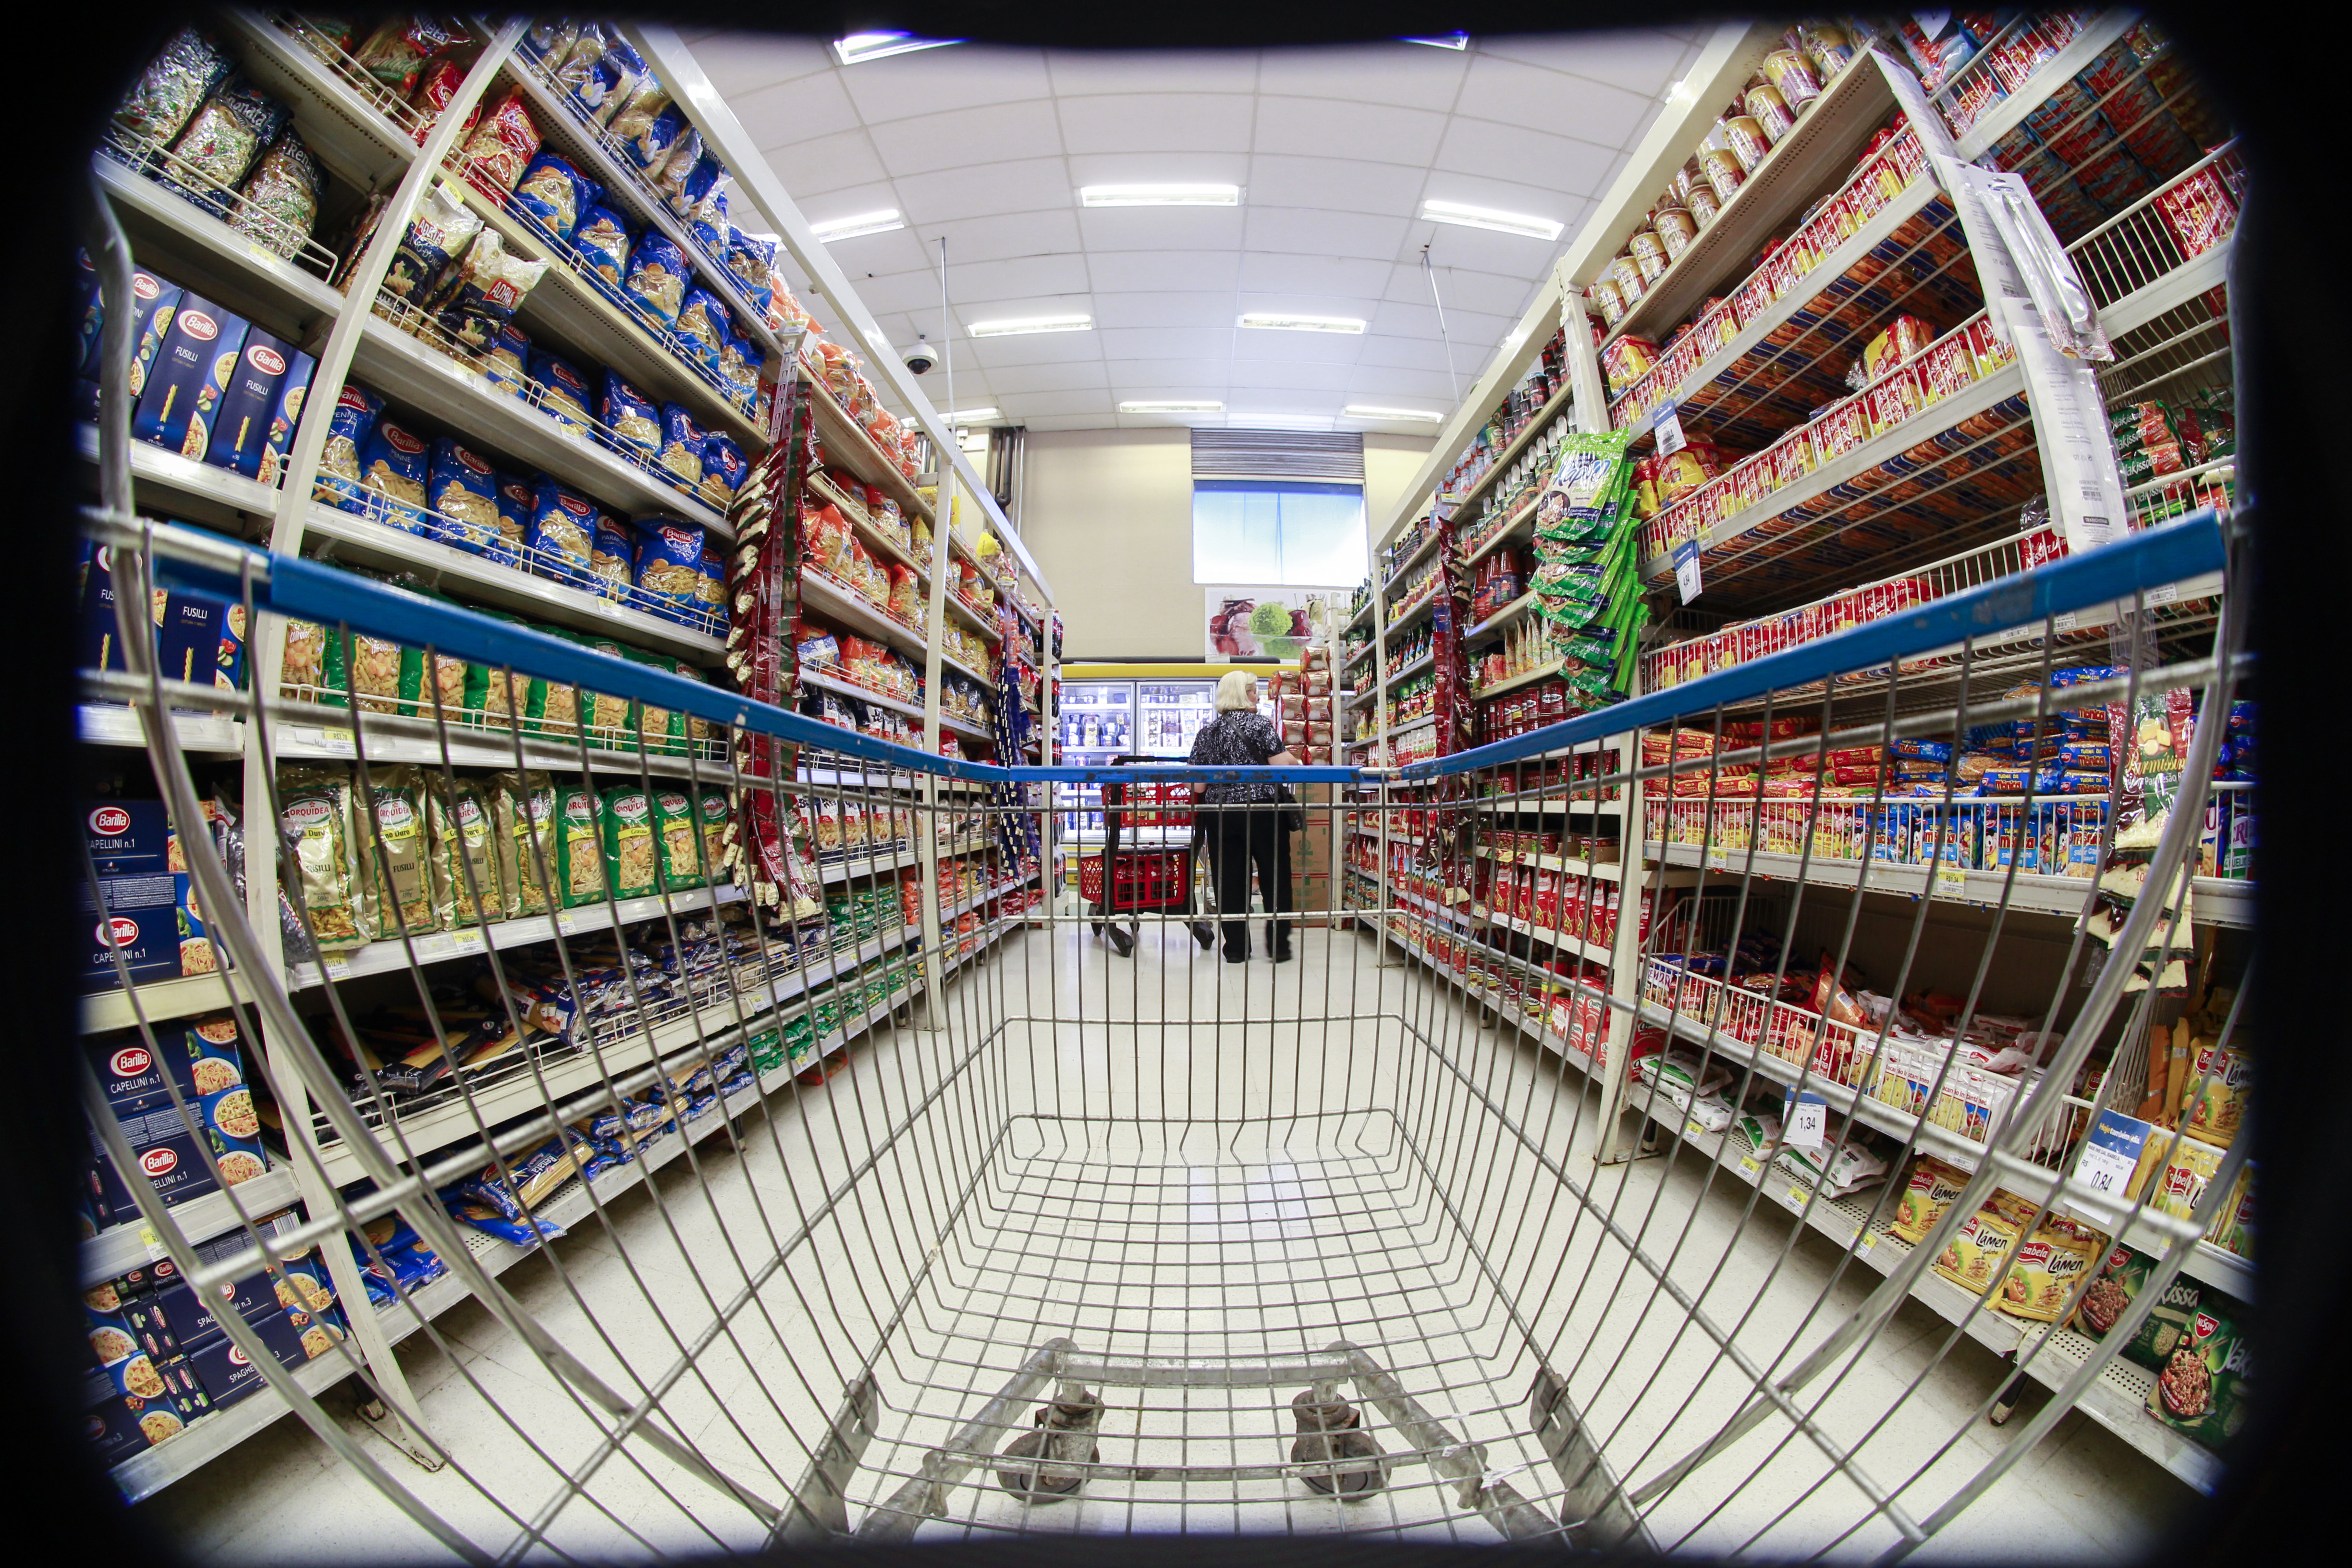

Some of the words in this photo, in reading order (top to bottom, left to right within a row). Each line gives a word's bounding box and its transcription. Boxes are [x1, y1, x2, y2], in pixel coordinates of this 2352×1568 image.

[286, 143, 322, 188] Renata
[135, 278, 157, 296] Barilla
[490, 281, 515, 306] ADRIA
[186, 315, 216, 335] Barilla
[175, 346, 198, 362] FUSILLI
[255, 352, 283, 371] Barilla
[246, 380, 269, 396] FUSILLI
[390, 430, 422, 451] Barilla
[390, 448, 412, 463] PENNE
[462, 452, 489, 472] Barilla
[561, 497, 587, 514] Barilla
[665, 528, 694, 543] Barilla
[1867, 595, 1889, 612] Nissin
[1891, 587, 1915, 600] Lámen
[183, 606, 208, 619] FUSILLI
[1746, 641, 1767, 654] Nissin
[2077, 707, 2106, 722] Mônica
[2077, 756, 2106, 767] Mônica
[1995, 780, 2022, 790] Mônica
[290, 806, 330, 816] ORQUIDEA
[380, 807, 409, 817] ORQUIDEA
[616, 799, 648, 813] ORQUIDEA
[99, 813, 126, 826] Barilla
[394, 829, 410, 837] Duro
[124, 838, 135, 848] n.1
[393, 863, 415, 872] FUSILLI
[135, 948, 146, 958] n.1
[120, 1053, 147, 1069] Barilla
[110, 1077, 147, 1094] CAPELLINI
[149, 1074, 160, 1084] n.1
[1800, 1116, 1816, 1132] 1,34
[147, 1152, 174, 1169] Barilla
[530, 1154, 558, 1174] Renata
[177, 1171, 187, 1182] n.1
[2091, 1170, 2113, 1193] 0,84
[486, 1181, 509, 1199] Renata
[1976, 1229, 2008, 1249] Lámen
[2047, 1255, 2083, 1273] Lámen
[2197, 1317, 2215, 1332] NISSIN
